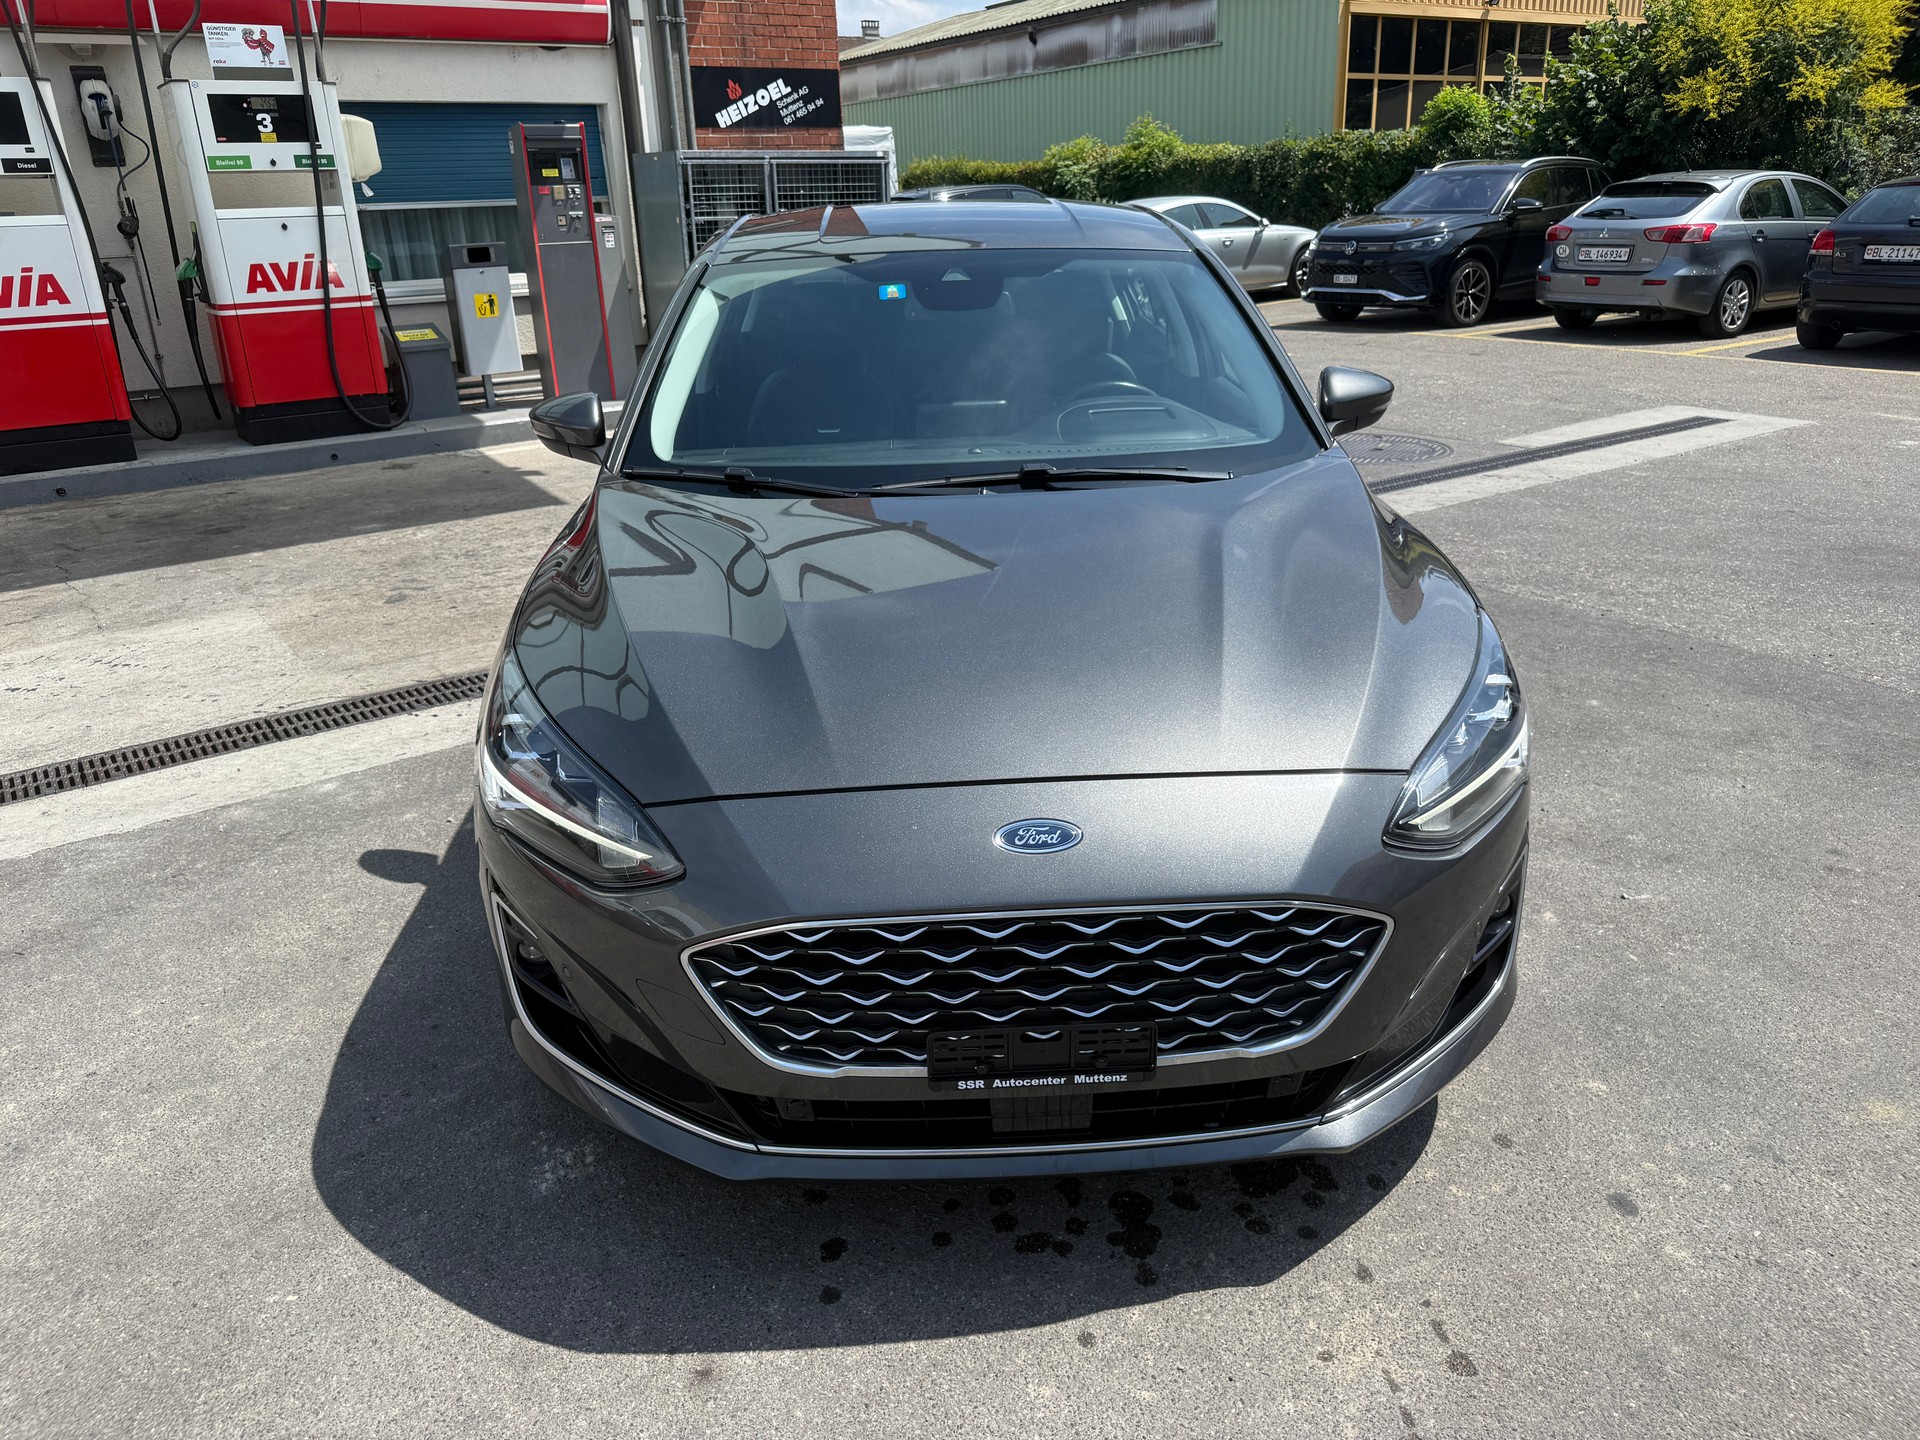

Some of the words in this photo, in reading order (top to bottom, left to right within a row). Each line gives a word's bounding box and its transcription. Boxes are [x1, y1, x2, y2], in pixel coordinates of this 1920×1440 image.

[715, 78, 792, 129] HEIZOEL
[776, 92, 799, 109] Schenk
[798, 85, 809, 98] AG
[780, 100, 805, 117] Muttenz
[783, 114, 796, 126] 061
[795, 108, 808, 119] 465
[806, 103, 816, 113] 94
[815, 97, 825, 107] 94
[256, 113, 274, 133] 3
[1014, 826, 1062, 845] Ford
[957, 1080, 985, 1090] SSR
[992, 1075, 1067, 1089] Autocenter
[1074, 1073, 1128, 1085] Muttenz
